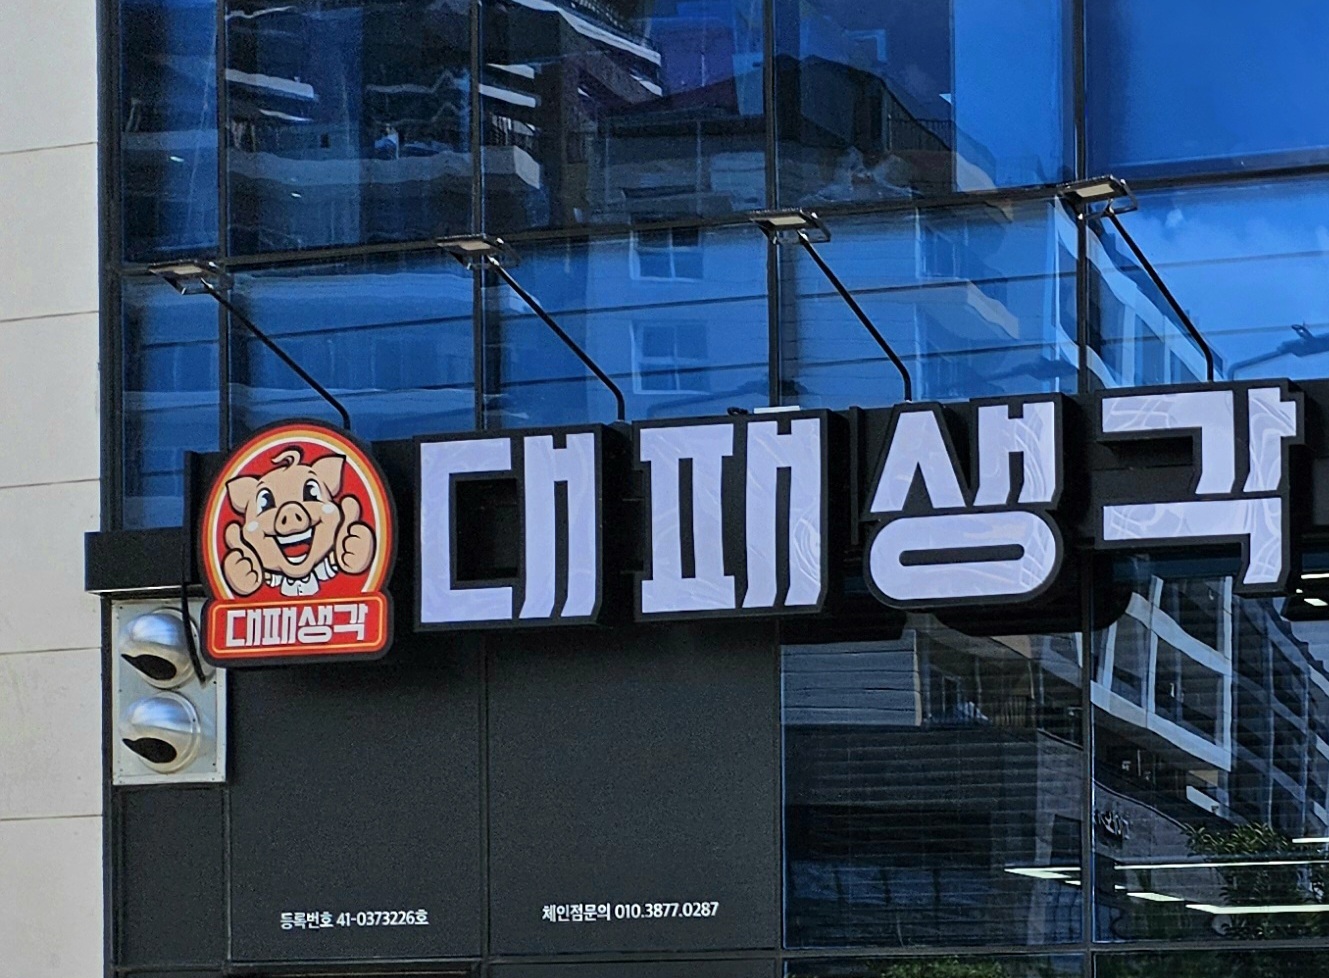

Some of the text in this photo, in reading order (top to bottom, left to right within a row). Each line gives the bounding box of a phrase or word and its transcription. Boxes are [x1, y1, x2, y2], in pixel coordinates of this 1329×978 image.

[419, 387, 1300, 623] 대패생각
[225, 604, 369, 648] 대패생각
[280, 908, 430, 930] 등록번호 41-0373226호
[542, 901, 720, 923] 체인점문의 010.3877.0287
